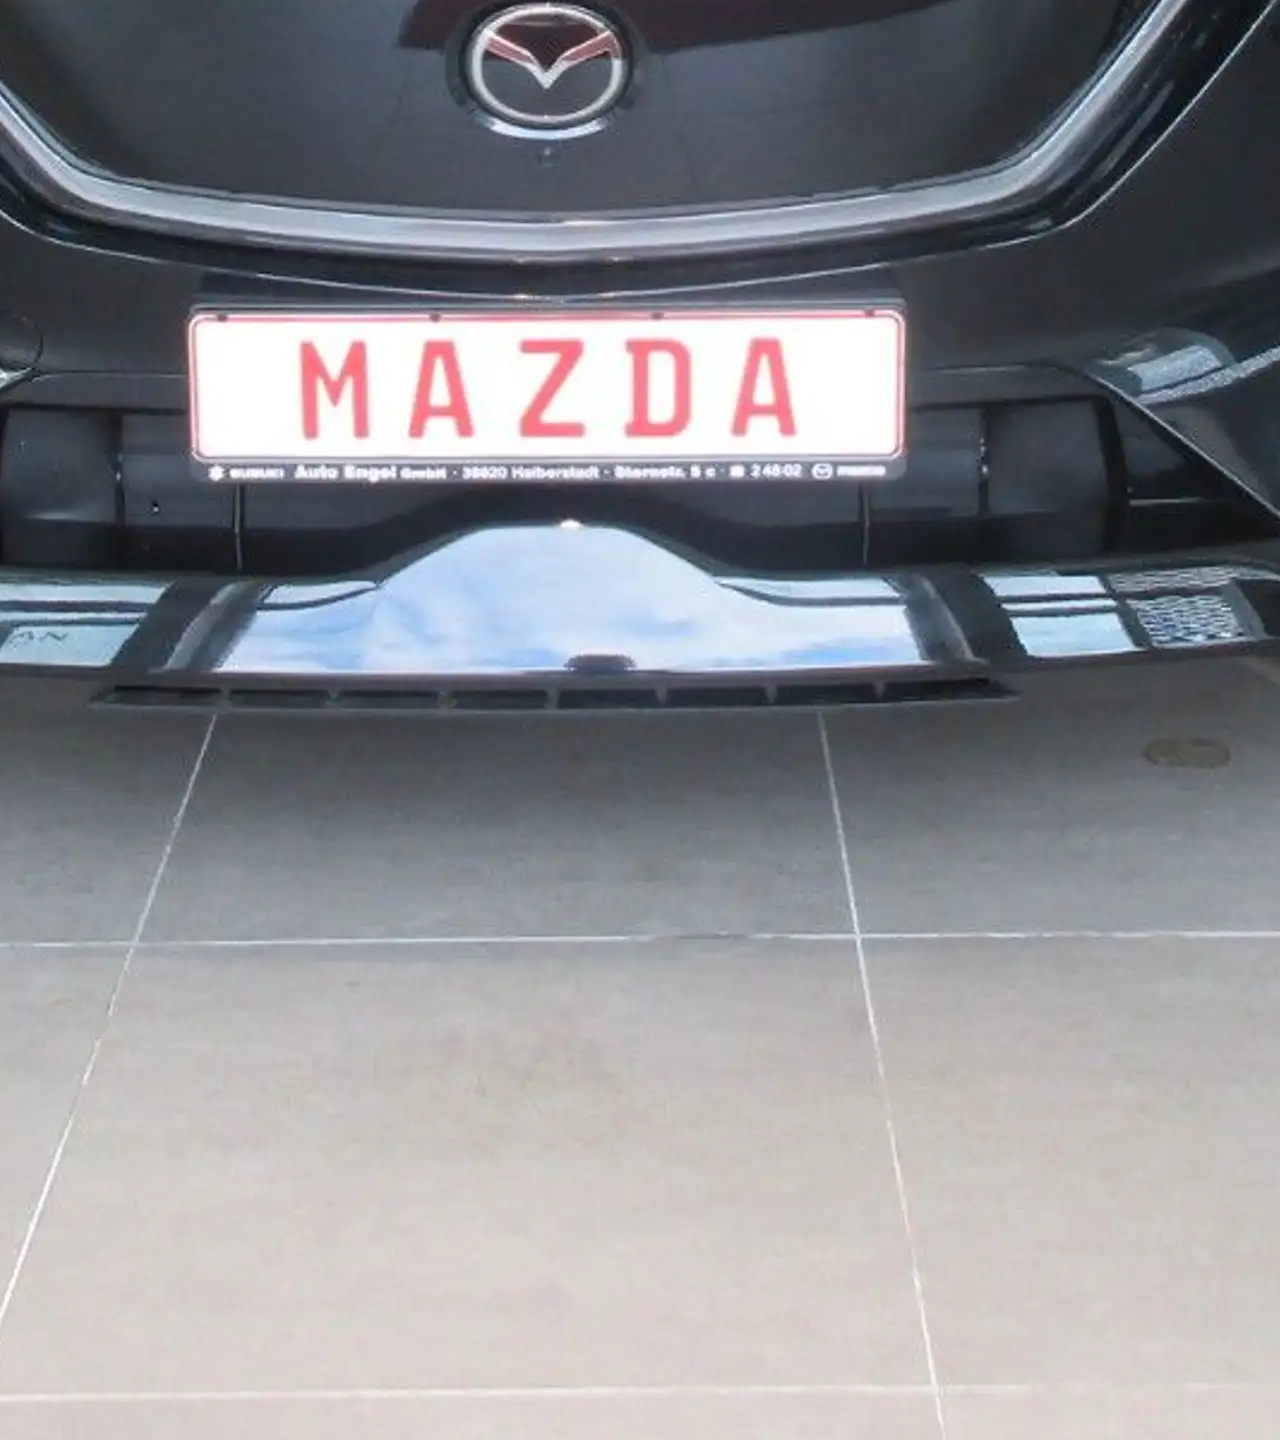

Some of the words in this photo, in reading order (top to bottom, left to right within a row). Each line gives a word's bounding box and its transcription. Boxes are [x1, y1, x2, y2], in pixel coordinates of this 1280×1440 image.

[298, 336, 798, 441] MAZDA
[293, 464, 340, 480] Auto
[343, 464, 398, 483] Engel
[511, 465, 600, 480] Halberstadt
